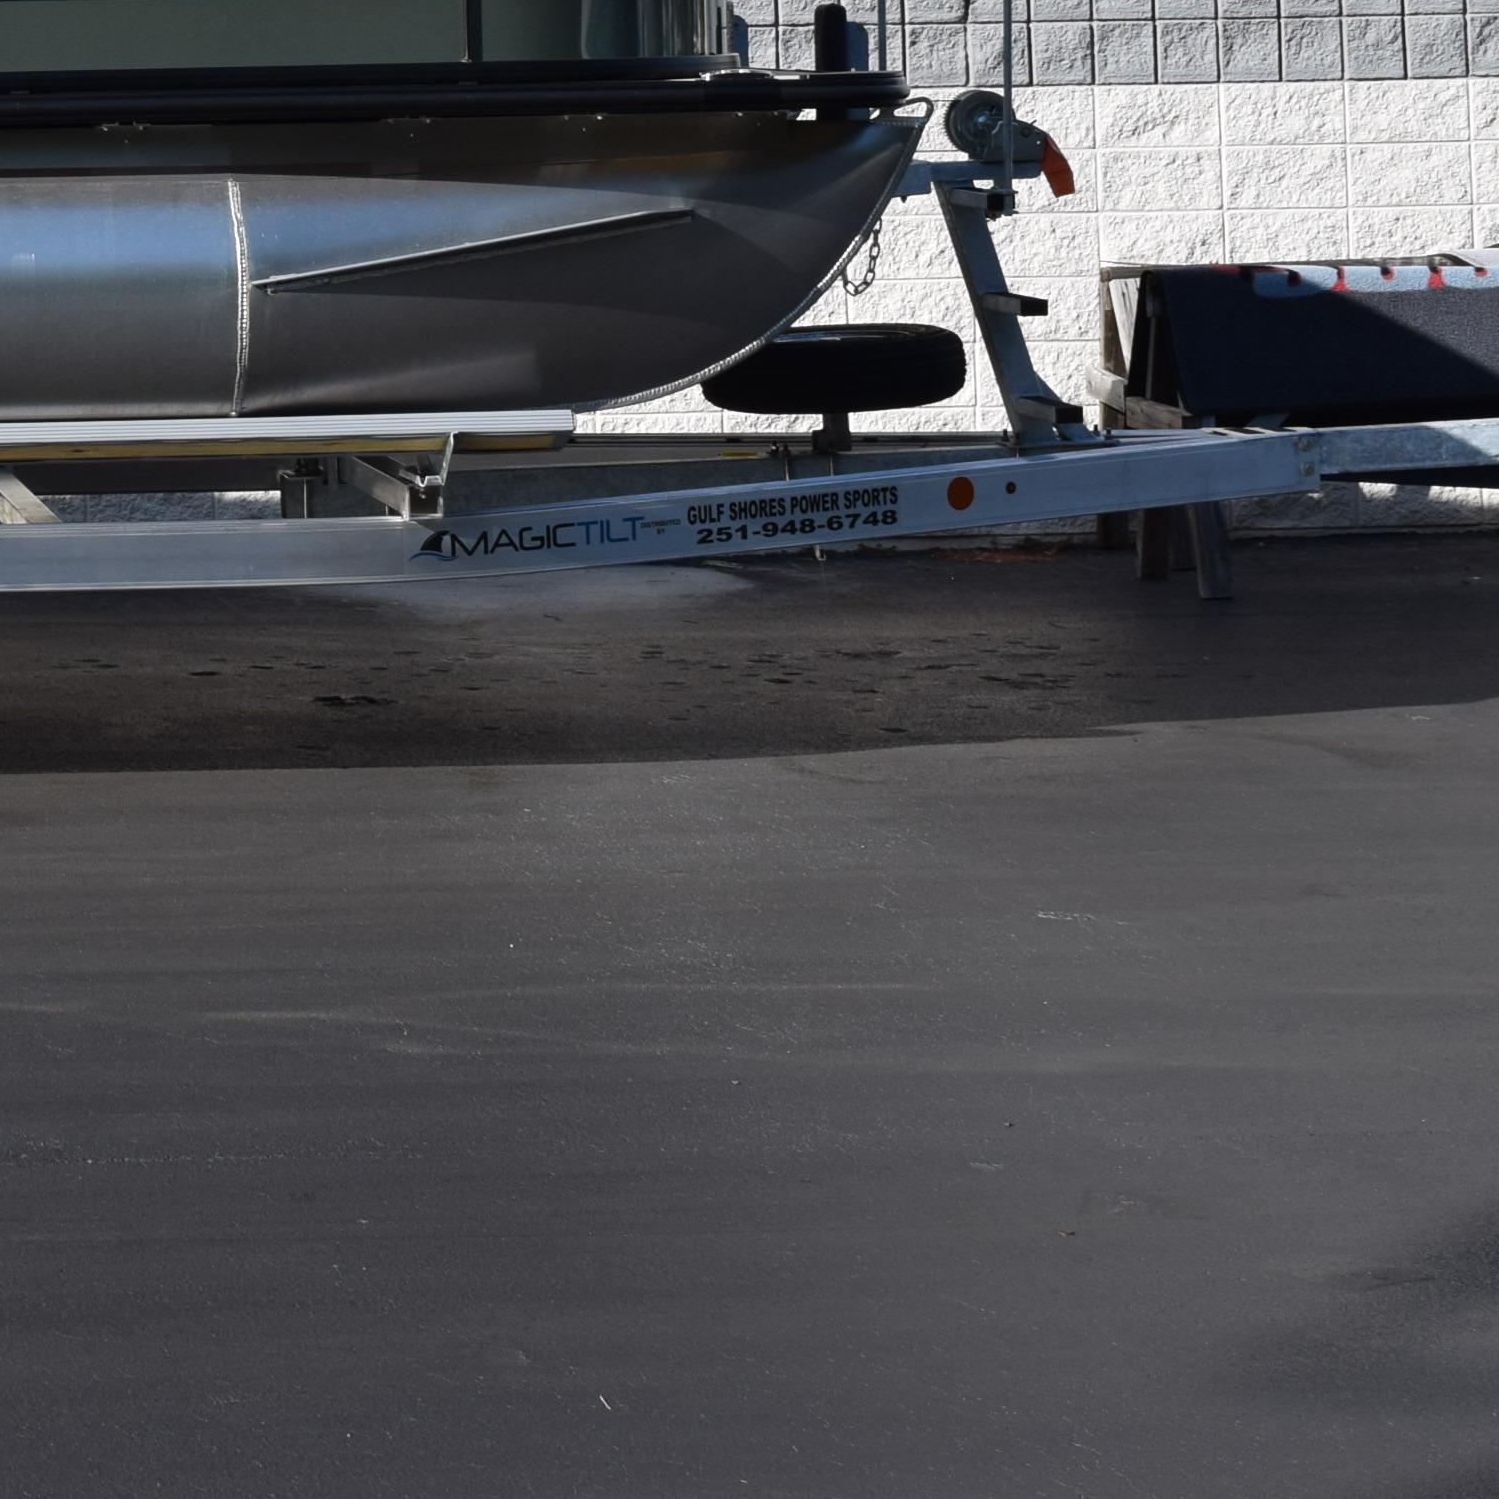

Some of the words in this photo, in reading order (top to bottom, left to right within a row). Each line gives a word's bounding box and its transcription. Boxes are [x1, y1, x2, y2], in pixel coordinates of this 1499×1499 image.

[687, 503, 725, 525] GULF
[729, 498, 786, 521] SHORES
[791, 492, 840, 515] POWER
[843, 486, 898, 510] SPORTS
[696, 509, 898, 544] 251-948-6748
